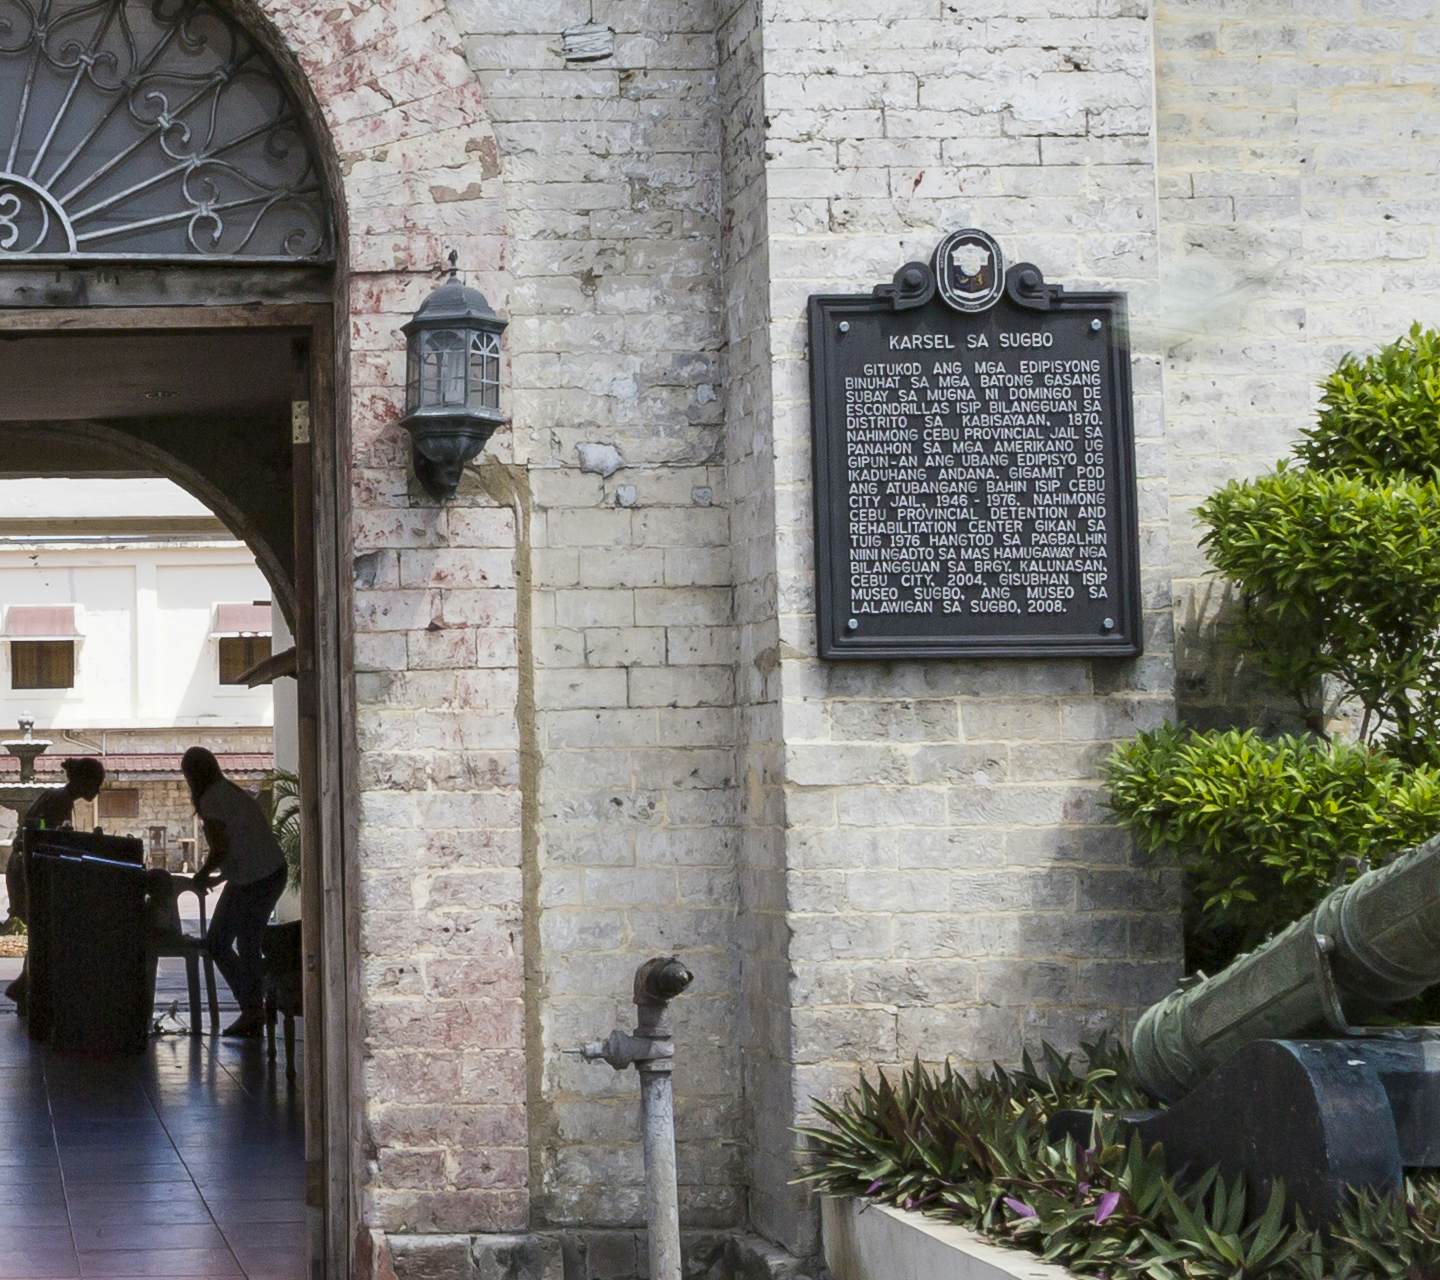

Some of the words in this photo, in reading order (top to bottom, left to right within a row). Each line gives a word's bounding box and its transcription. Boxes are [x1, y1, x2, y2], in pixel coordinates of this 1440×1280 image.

[889, 335, 956, 349] KARSEL
[966, 334, 989, 348] SA
[999, 333, 1054, 348] SUGBO
[863, 362, 922, 377] GITUKOD
[932, 362, 963, 376] ANG
[974, 361, 1007, 375] MGA
[1019, 360, 1101, 375] EDIPISYONG
[844, 375, 901, 390] BINUHAT
[910, 375, 930, 389] SA
[938, 375, 971, 389] MGA
[980, 374, 1034, 388] BATONG
[1044, 373, 1102, 388] GASANG
[845, 389, 889, 403] SUBAY
[898, 389, 918, 402] SA
[926, 388, 977, 402] MUGNA
[985, 388, 999, 401] NI
[1009, 387, 1072, 401] DOMINGO
[1083, 387, 1102, 400] DE
[846, 402, 950, 416] ESCONDRILLAS
[956, 401, 982, 415] ISIP
[989, 400, 1078, 414] BILANGGUAN
[1083, 400, 1103, 413] SA
[846, 415, 908, 429] DISTRITO
[924, 415, 944, 428] SA
[962, 414, 1051, 429] KABISAYAAN,
[1068, 413, 1104, 426] 1870.
[846, 428, 919, 442] NAHIMONG
[923, 428, 960, 441] CEBU
[964, 427, 1045, 441] PROVINCIAL
[1049, 426, 1080, 440] JAIL
[1084, 426, 1104, 439] SA
[847, 441, 912, 455] PANAHON
[922, 441, 943, 454] SA
[952, 441, 984, 454] MGA
[993, 440, 1074, 453] AMERIKANO
[1084, 439, 1104, 452] UG
[847, 454, 918, 469] GIPUN-AN
[924, 454, 955, 468] ANG
[961, 453, 1009, 468] UBANG
[1017, 453, 1078, 467] EDIPISYO
[1084, 452, 1104, 466] OG
[848, 468, 927, 482] IKADUHANG
[938, 467, 1000, 481] ANDANA.
[1008, 467, 1065, 480] GIGAMIT
[1076, 466, 1105, 480] POD
[848, 482, 878, 495] ANG
[885, 481, 978, 495] ATUBANGANG
[986, 480, 1027, 494] BAHIN
[1035, 480, 1061, 493] ISIP
[1068, 479, 1106, 493] CEBU
[849, 508, 887, 522] CEBU
[897, 507, 979, 521] PROVINCIAL
[990, 506, 1068, 521] DETENTION
[1077, 505, 1107, 520] AND
[849, 520, 957, 535] REHABILITATION
[968, 519, 1023, 534] CENTER
[1034, 519, 1076, 533] GIKAN
[1087, 519, 1106, 533] SA
[850, 535, 882, 548] TUIG
[890, 534, 921, 548] 1976
[929, 534, 994, 547] HANGTOD
[1002, 533, 1022, 547] SA
[1031, 533, 1107, 546] PAGBALHIN
[850, 561, 940, 575] BILANGGUAN
[947, 561, 967, 574] SA
[974, 561, 1013, 574] BRGY.
[1019, 560, 1108, 574] KALUNASAN,
[850, 588, 899, 601] MUSEO
[913, 587, 965, 601] SUGBO,
[980, 587, 1011, 600] ANG
[1026, 586, 1075, 599] MUSEO
[1088, 586, 1108, 599] SA
[851, 600, 933, 615] LALAWIGAN
[942, 600, 962, 614] SA
[970, 600, 1022, 615] SUGBO,
[1027, 599, 1067, 614] 2008.
